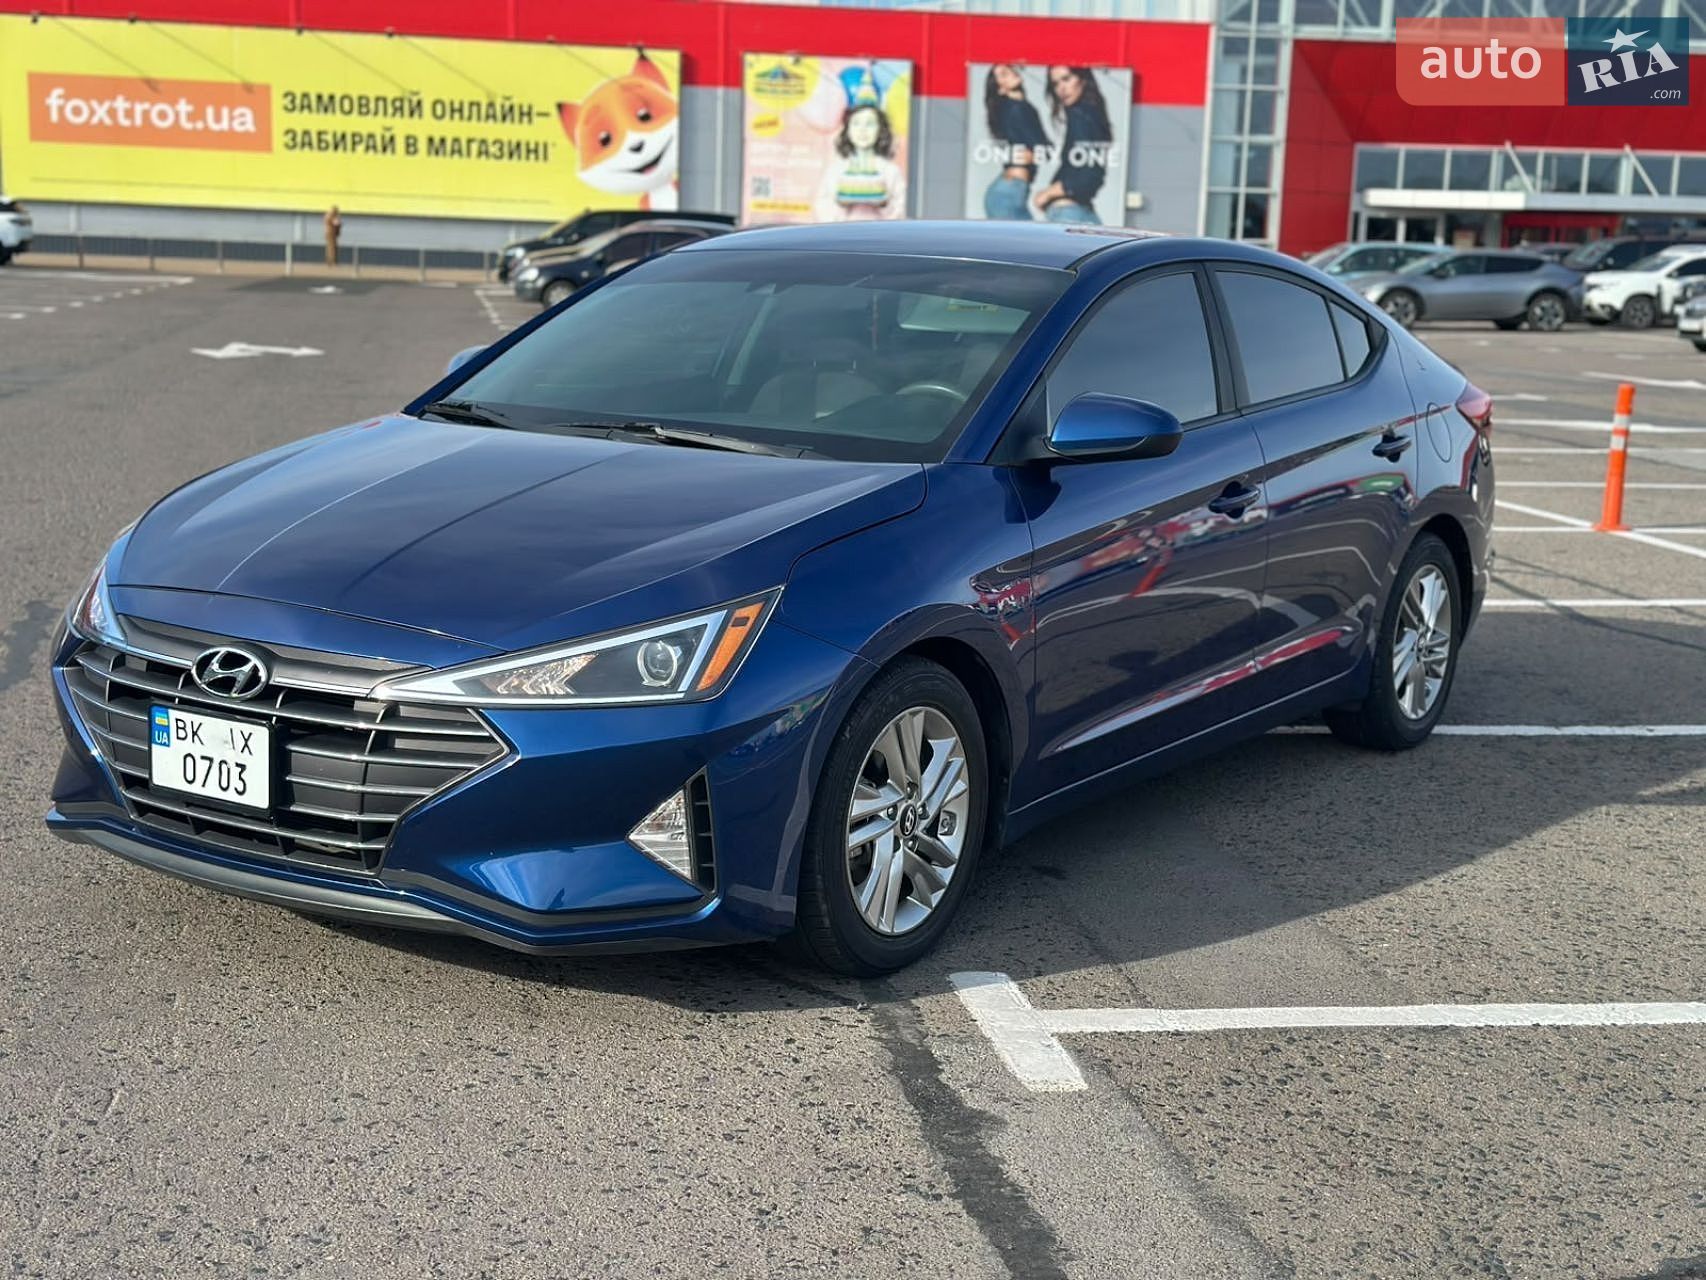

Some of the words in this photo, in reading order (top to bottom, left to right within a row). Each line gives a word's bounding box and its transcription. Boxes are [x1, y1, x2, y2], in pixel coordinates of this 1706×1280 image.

[44, 86, 257, 133] foxtrot.ua
[282, 90, 423, 120] ЗАМОВЛЯЙ
[283, 126, 396, 155] ЗАБИРАЙ
[404, 134, 418, 156] В
[974, 143, 1029, 166] ONE
[1033, 143, 1059, 166] BY
[1068, 145, 1120, 168] ONE
[155, 730, 169, 745] UA
[183, 752, 247, 796] 0703
